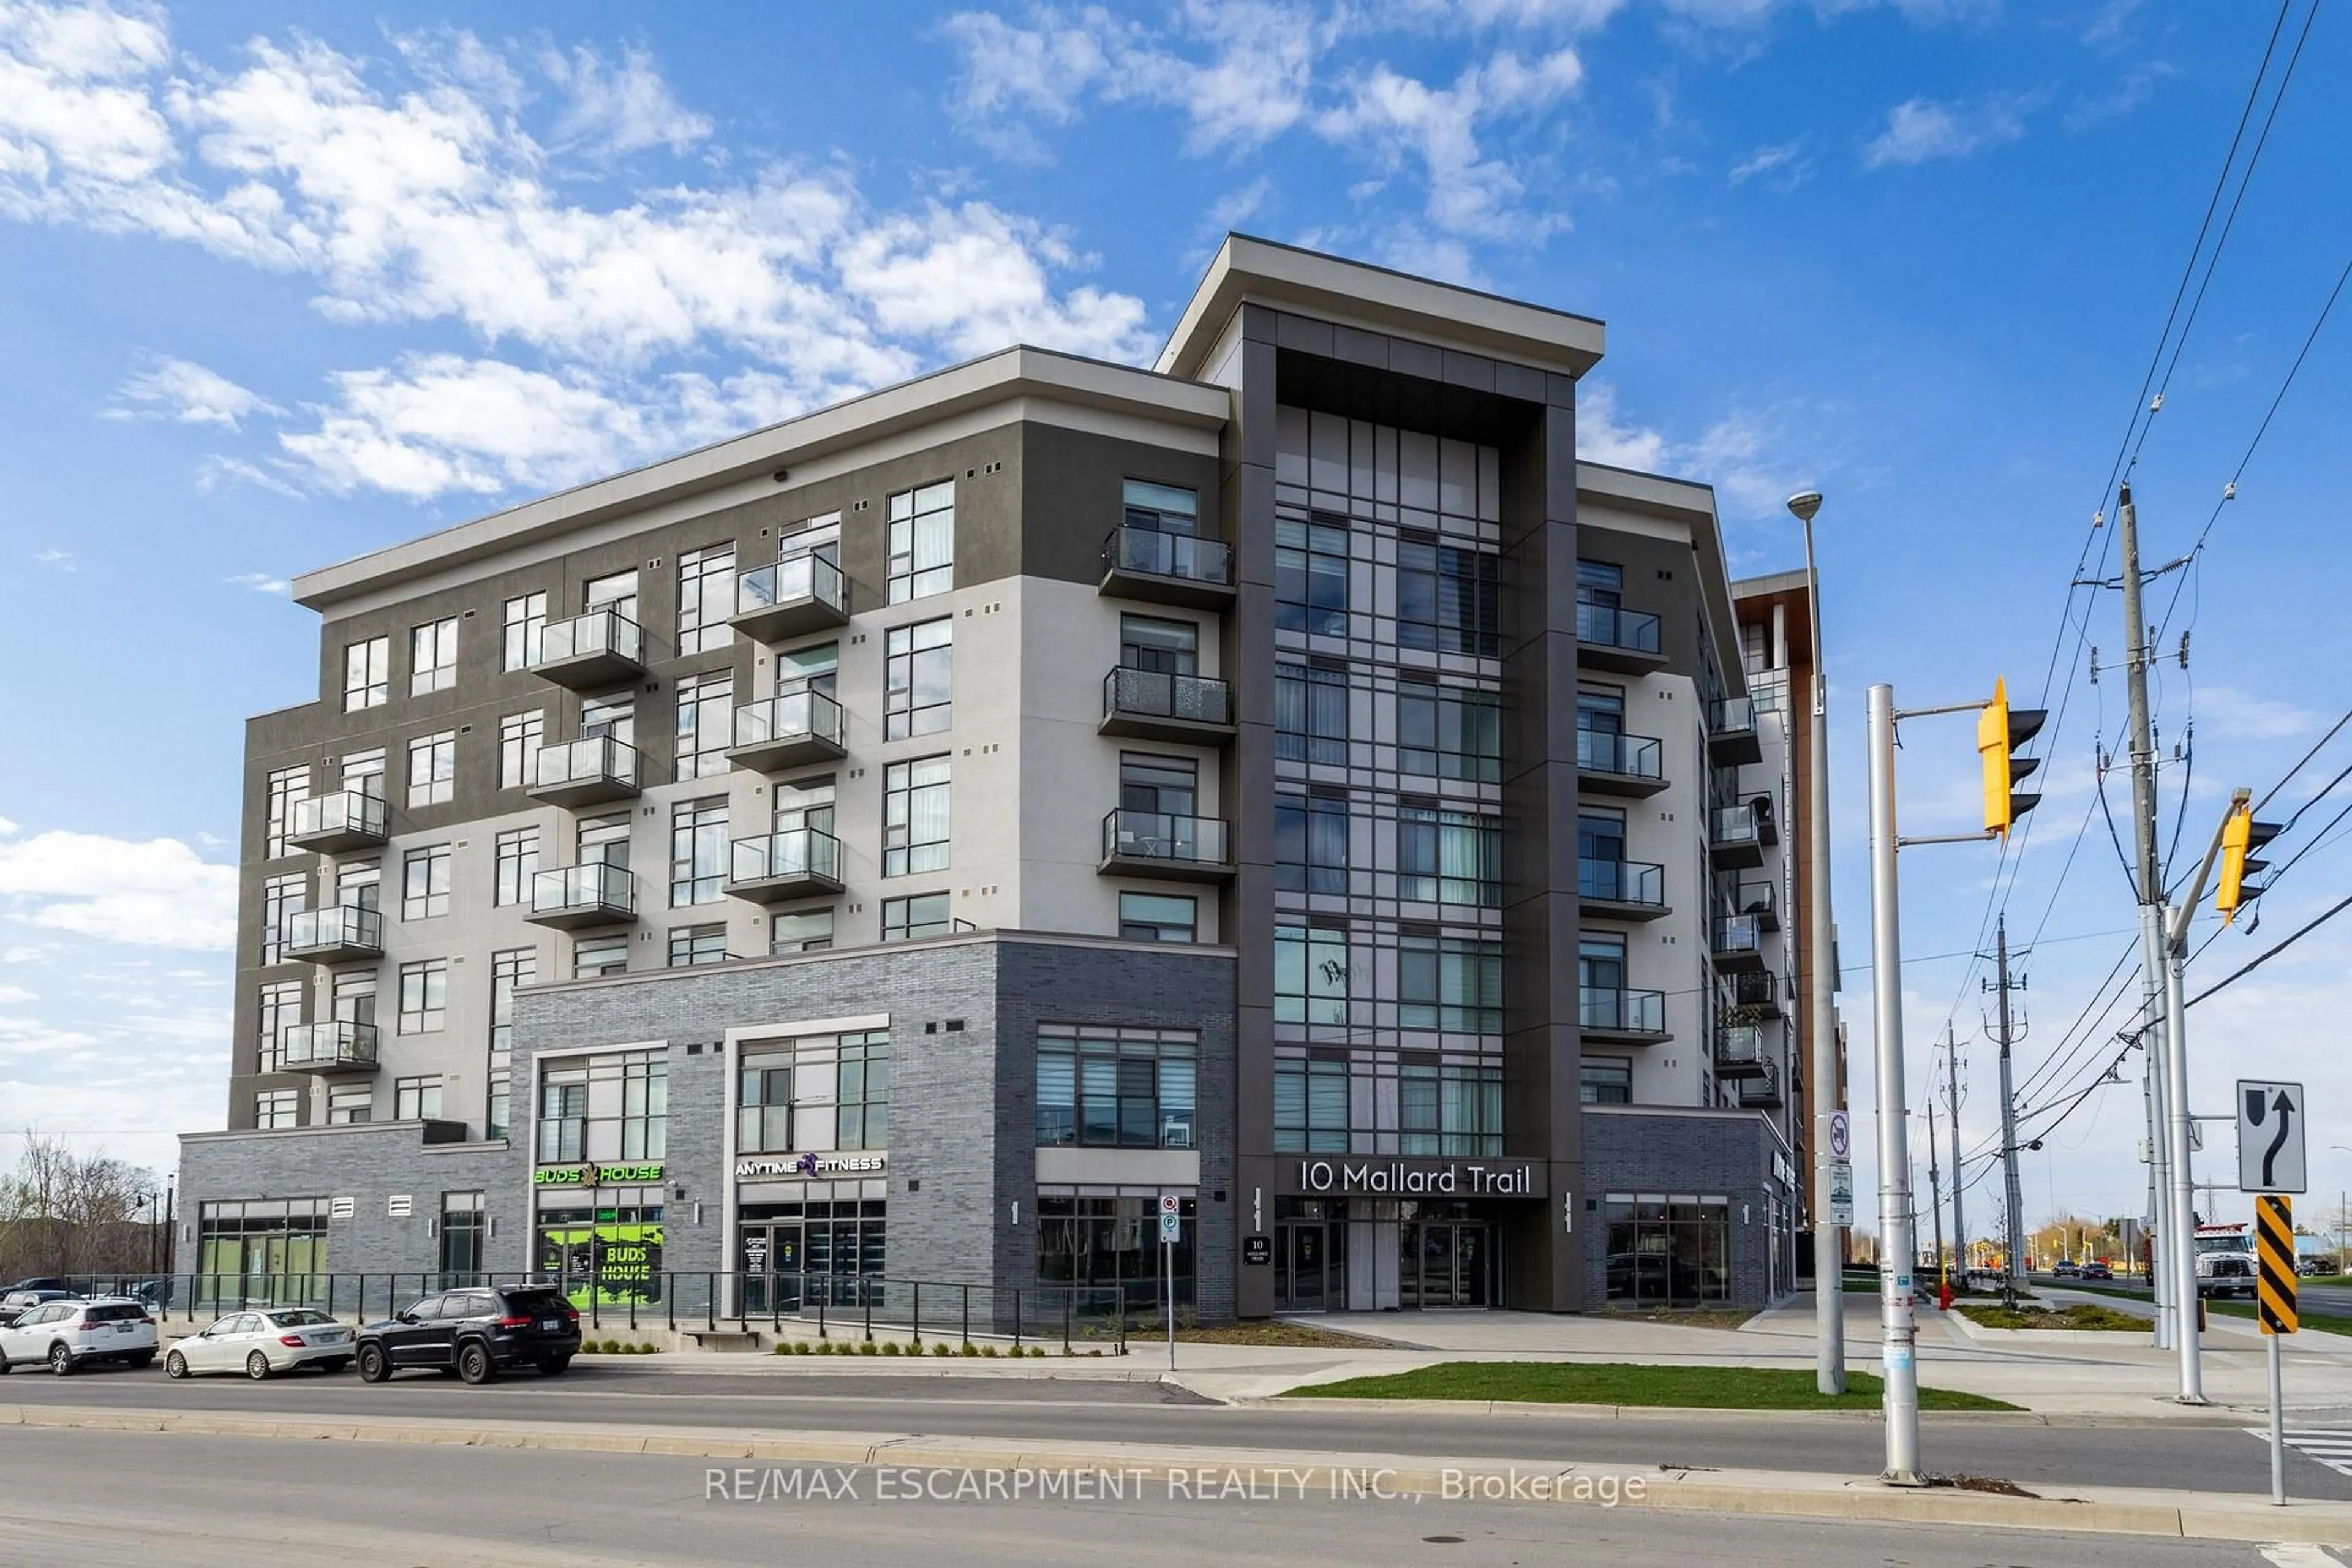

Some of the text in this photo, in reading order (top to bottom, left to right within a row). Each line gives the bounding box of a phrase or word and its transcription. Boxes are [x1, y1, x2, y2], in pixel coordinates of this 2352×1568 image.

[533, 1166, 662, 1183] BUDS HOUSE
[735, 1158, 883, 1175] ANYTIME FITNESS
[1302, 1161, 1530, 1193] 10 Mallard Trail
[1253, 1240, 1263, 1250] 10
[607, 1247, 647, 1262] BUDS
[601, 1265, 650, 1280] HOUSE
